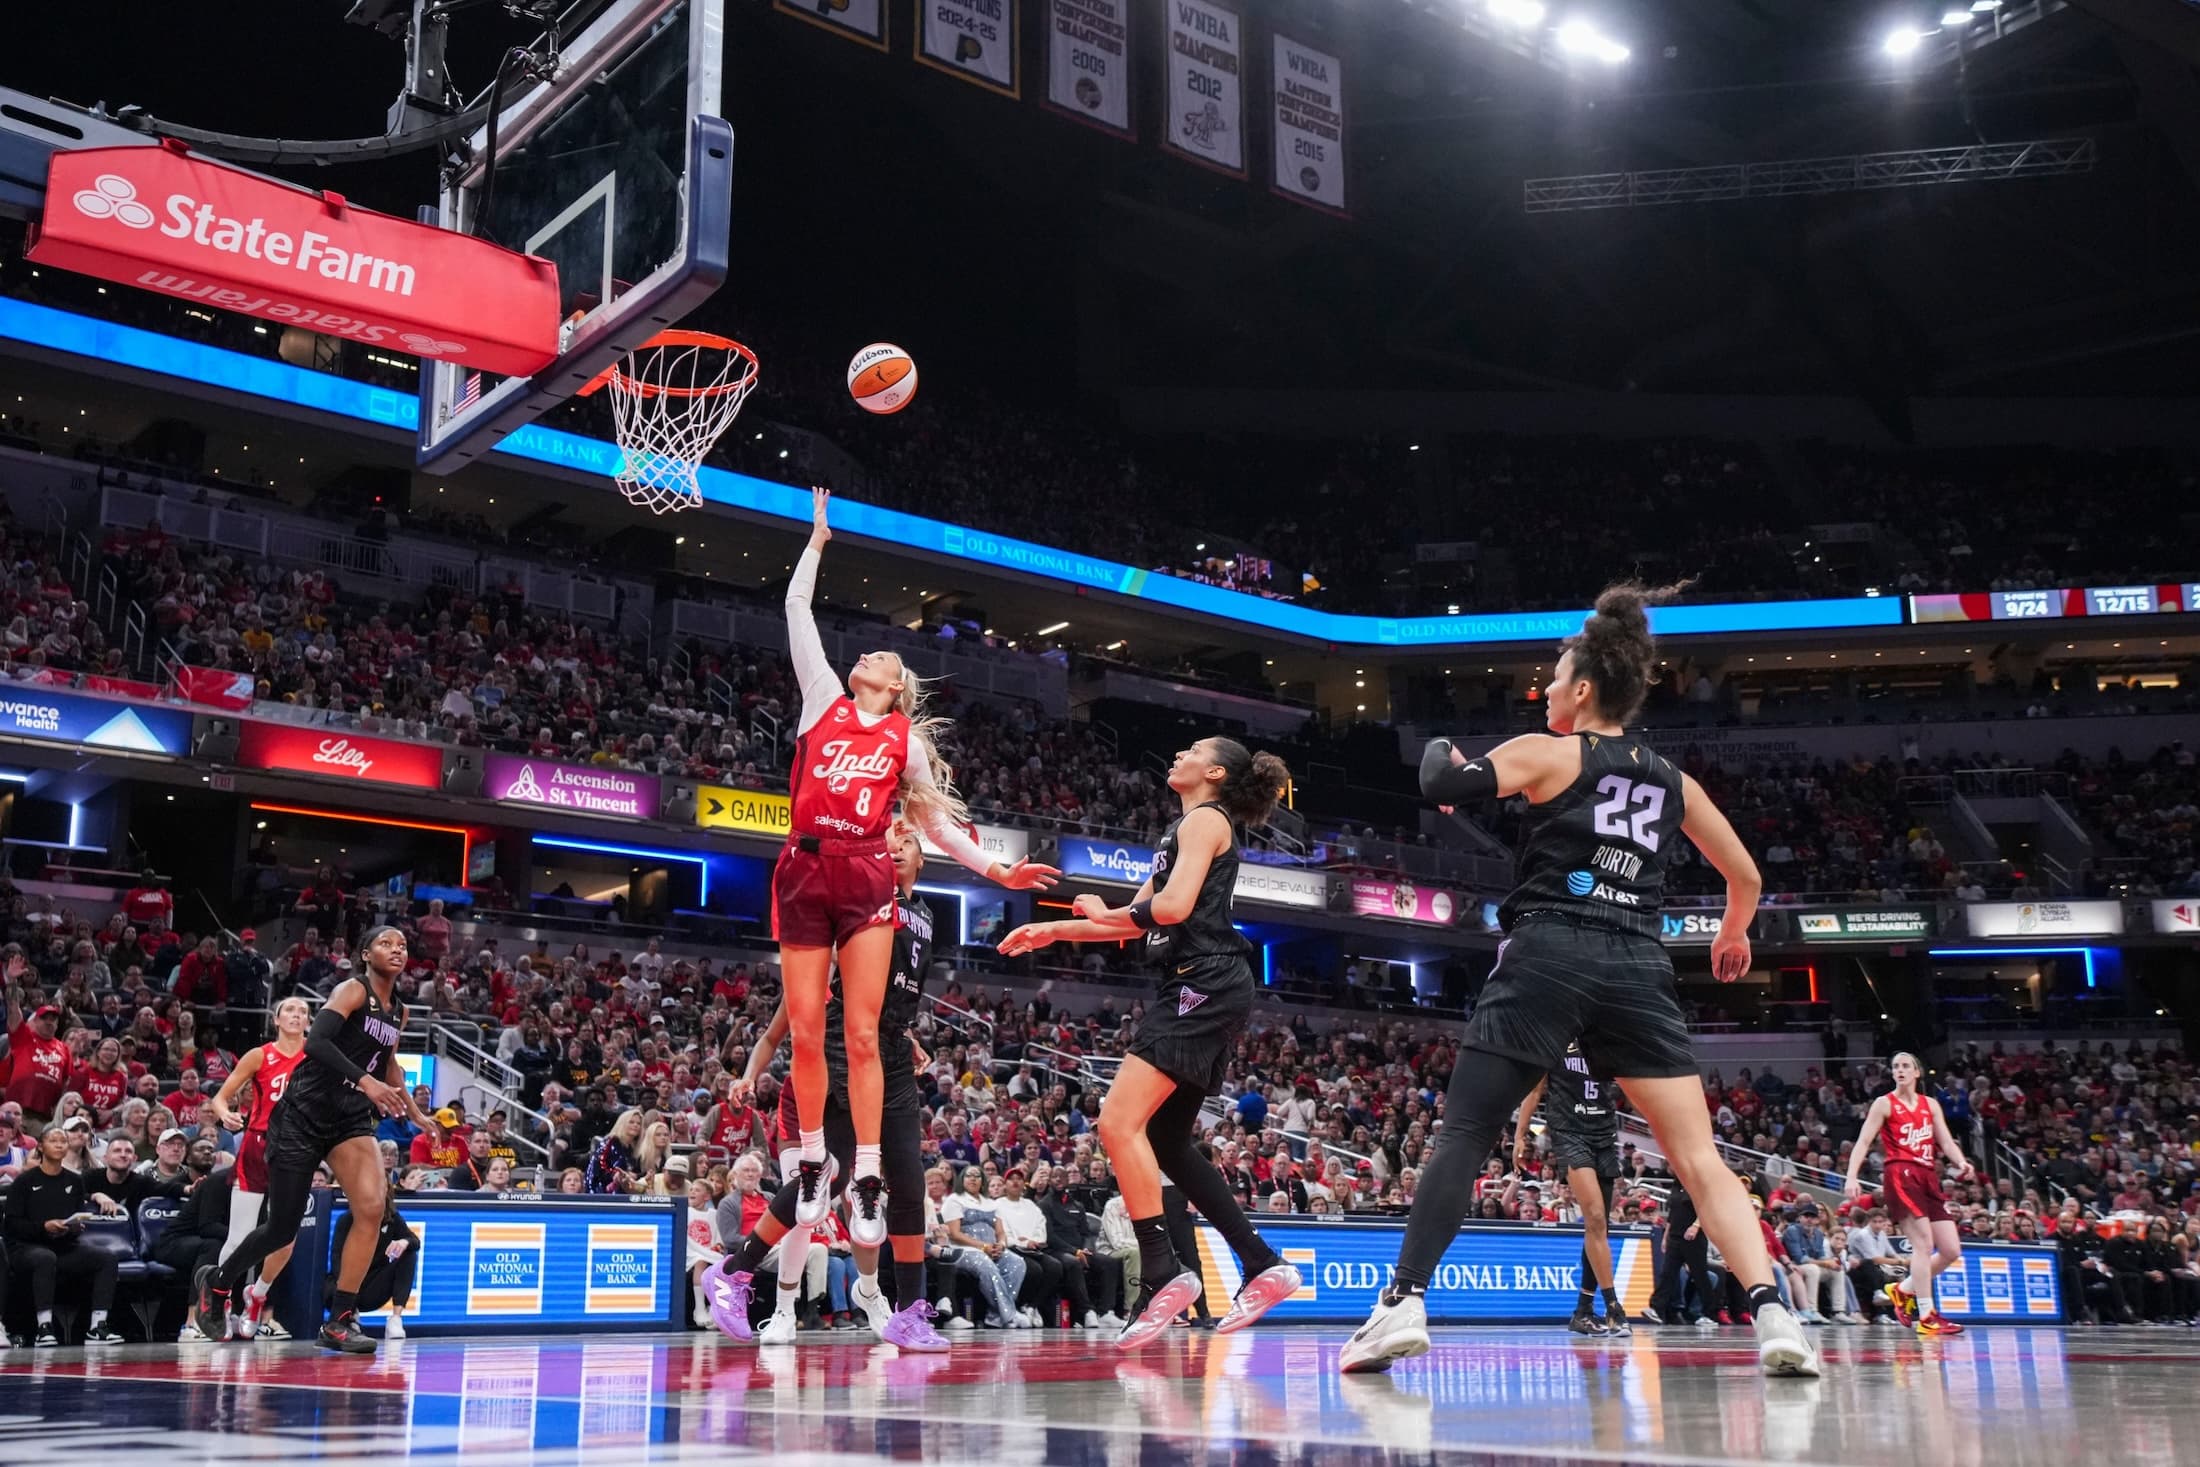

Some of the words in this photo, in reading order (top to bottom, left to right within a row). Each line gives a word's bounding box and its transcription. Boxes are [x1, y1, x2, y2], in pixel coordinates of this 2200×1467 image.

[937, 6, 997, 42] 2024-25
[1177, 1, 1231, 43] WNBA
[1056, 17, 1122, 56] CHAMPIONS
[1072, 48, 1106, 77] 2009
[1173, 30, 1238, 76] CHAMPIONS
[1286, 51, 1328, 83] WNBA
[1187, 69, 1222, 101] 2012
[1284, 78, 1332, 108] EASTERN
[1277, 91, 1341, 127] CONFERENCE
[1279, 108, 1339, 142] CHAMPIONS
[1295, 138, 1325, 162] 2015
[851, 348, 894, 373] Wilson
[553, 439, 604, 465] BANK
[966, 537, 998, 555] OLD
[1001, 545, 1073, 574] NATIONAL
[1076, 563, 1115, 583] BANK
[2006, 600, 2048, 617] 9/24
[2096, 595, 2151, 613] 12/15
[1401, 622, 1435, 637] OLD
[1439, 620, 1523, 636] NATIONAL
[1526, 617, 1572, 632] BANK
[16, 715, 59, 731] Health
[313, 739, 373, 776] Lilly
[813, 740, 895, 780] Indy
[551, 767, 636, 794] Ascension
[550, 788, 572, 806] St.
[574, 791, 638, 814] Vincent
[855, 787, 873, 817] 8
[1594, 774, 1667, 853] 22
[814, 815, 865, 836] salesforce
[983, 837, 1005, 853] 107.5
[1108, 849, 1151, 881] Kroger
[1591, 845, 1643, 882] BURTON
[1592, 882, 1640, 905] AT&T
[1804, 919, 1834, 929] WM
[1846, 913, 1879, 922] WE'RE
[1880, 912, 1921, 922] DRIVING
[911, 941, 922, 969] 5
[366, 1051, 381, 1072] 6
[88, 1082, 119, 1095] FEVER
[1584, 1080, 1599, 1099] 15
[92, 1094, 110, 1109] 22
[511, 1193, 543, 1201] HYUNDAI
[642, 1194, 672, 1203] HYUNDAI
[479, 1263, 535, 1274] NATIONAL
[496, 1253, 521, 1263] OLD
[595, 1263, 649, 1274] NATIONAL
[611, 1253, 635, 1263] OLD
[491, 1274, 523, 1285] BANK
[607, 1274, 637, 1285] BANK
[1324, 1262, 1379, 1289] OLD
[1513, 1265, 1579, 1291] BANK
